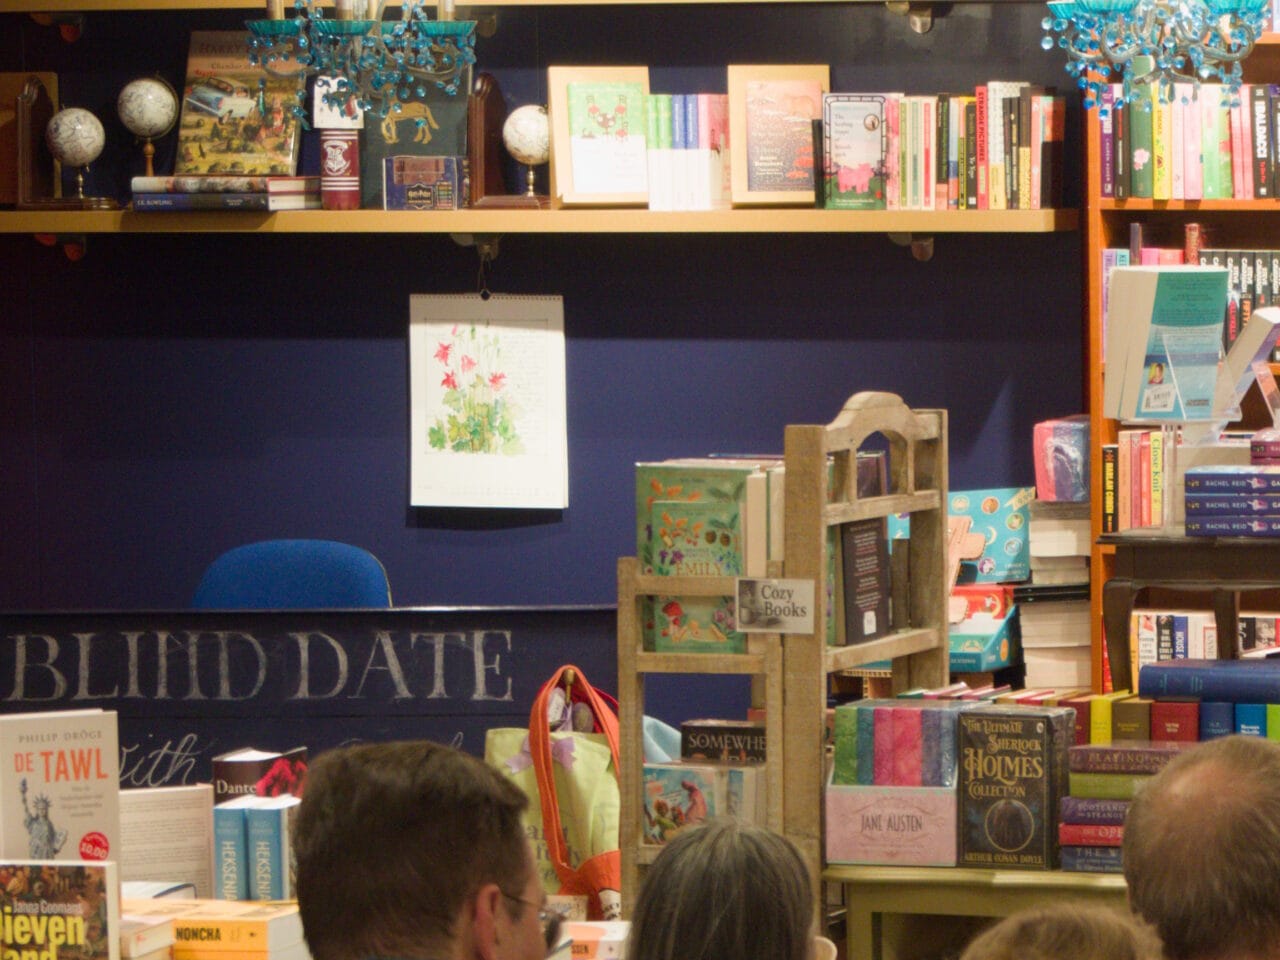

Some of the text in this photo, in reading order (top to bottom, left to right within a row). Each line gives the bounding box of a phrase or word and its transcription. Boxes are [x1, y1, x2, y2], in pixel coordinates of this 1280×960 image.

[1255, 106, 1267, 158] BALDACCI
[978, 126, 986, 161] PICTURES
[1152, 438, 1161, 493] Close Knit
[1105, 462, 1114, 490] HARLAN
[675, 562, 723, 577] EMILY
[761, 584, 794, 603] Cozy
[765, 601, 808, 618] Books
[7, 629, 515, 702] BLIND DATE
[982, 719, 1024, 734] ULTIMATE
[18, 733, 58, 744] PHILIP
[987, 734, 1043, 755] SHERLOCK
[14, 748, 109, 783] DE TAWL
[964, 747, 1045, 785] HOLMES
[216, 780, 257, 795] Dante
[968, 781, 1027, 800] COLLECTION
[860, 813, 923, 833] JANE AUSTEN
[964, 854, 1043, 864] ARTHUR CONAN DOYLE
[13, 901, 40, 914] Janna
[175, 927, 222, 941] NONCHA
